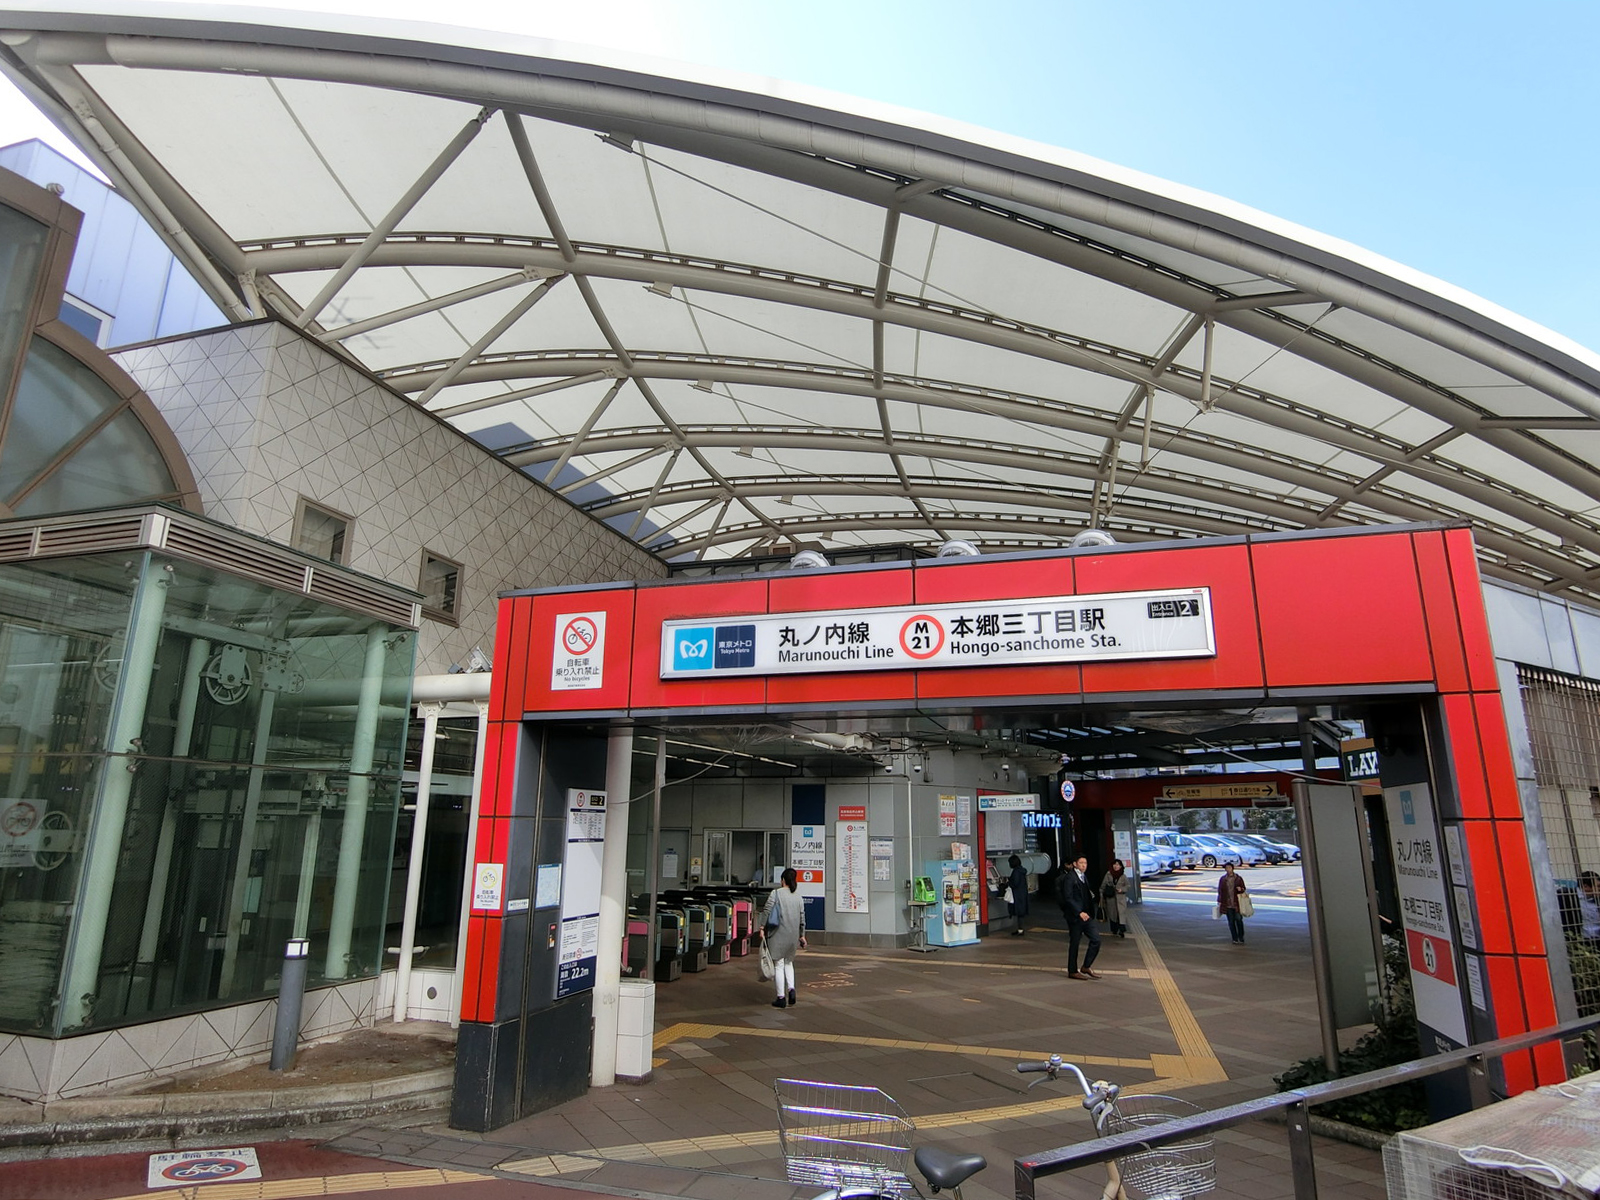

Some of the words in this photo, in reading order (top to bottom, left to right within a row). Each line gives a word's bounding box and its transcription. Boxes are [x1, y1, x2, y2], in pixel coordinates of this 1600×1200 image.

[1151, 603, 1173, 611] 出入口
[1180, 601, 1192, 615] 2
[914, 622, 929, 634] M
[950, 608, 1106, 638] 本郷三丁目駅
[778, 621, 871, 648] 丸ノ内線
[718, 640, 752, 648] 東京メトロ
[911, 636, 931, 649] 21
[950, 636, 1085, 657] Hongo-sanchome
[1090, 633, 1122, 648] Sta.
[778, 645, 860, 663] Marunouchi
[865, 645, 894, 659] Line
[567, 658, 590, 667] 自転車
[555, 667, 600, 677] 乗り入れ禁止
[1228, 787, 1233, 796] 1
[599, 796, 604, 805] 2
[793, 841, 823, 850] 丸ノ内線
[1396, 839, 1434, 864] 丸ノ内線
[1398, 864, 1427, 878] Marunouchi
[1426, 866, 1439, 879] Line
[1403, 896, 1444, 921] 本郷三丁目駅
[1426, 952, 1434, 968] 21
[571, 967, 589, 980] 22.2m
